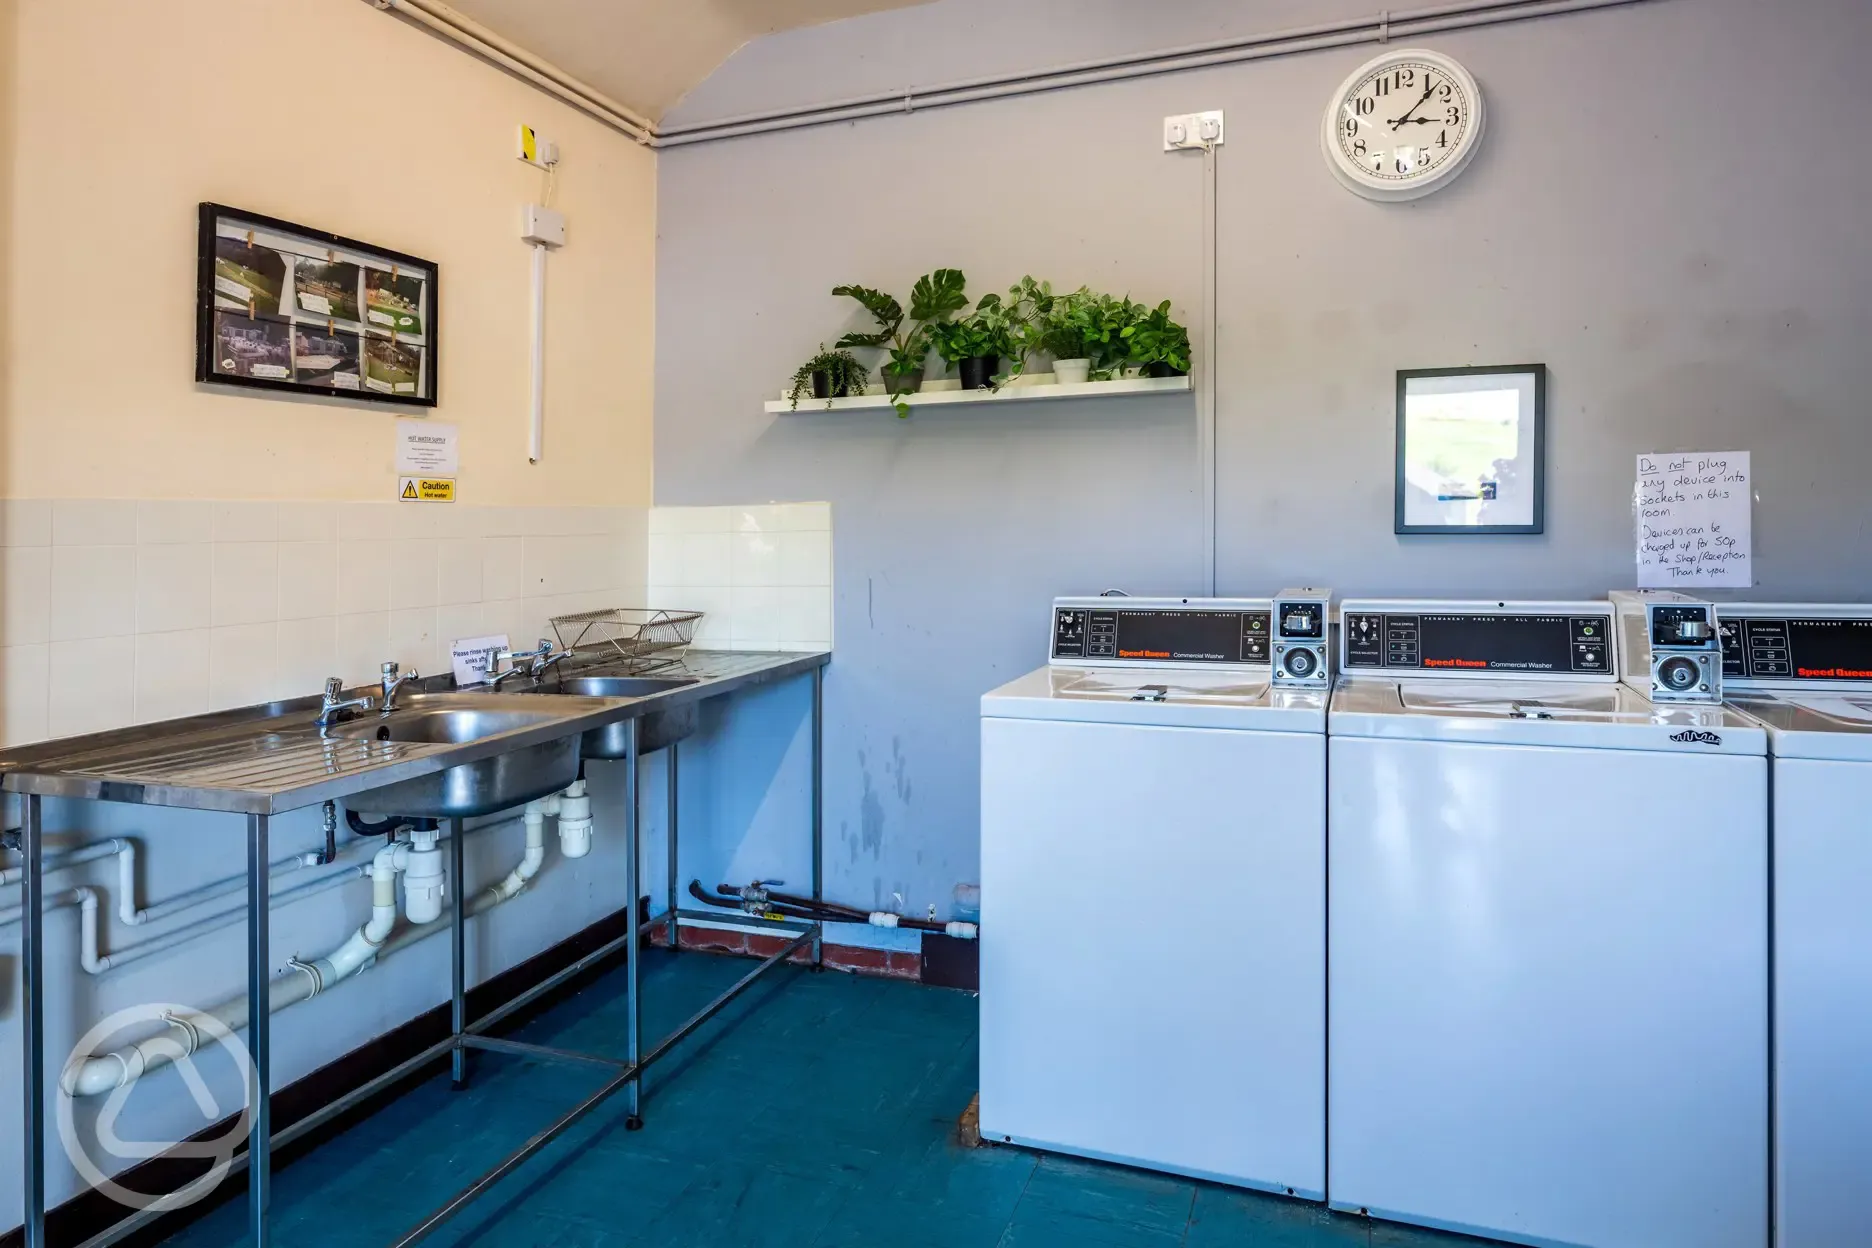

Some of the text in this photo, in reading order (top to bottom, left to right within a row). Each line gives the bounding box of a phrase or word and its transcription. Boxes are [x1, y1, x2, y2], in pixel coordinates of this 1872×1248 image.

[1375, 77, 1389, 96] 11
[1394, 69, 1414, 89] 12
[1424, 73, 1430, 92] 1
[1439, 84, 1452, 104] 2
[1355, 96, 1375, 116] 10
[1445, 106, 1460, 126] 3
[1346, 118, 1359, 138] 9
[1435, 129, 1448, 148] 4
[1353, 139, 1367, 157] 8
[1417, 146, 1431, 166] 5
[1640, 458, 1727, 475] Do not plug
[422, 481, 450, 491] Caution
[1673, 475, 1716, 486] device
[1724, 471, 1745, 482] into
[1707, 488, 1730, 499] this
[1643, 522, 1721, 539] Devices can be
[1641, 539, 1675, 555] charged
[1680, 542, 1691, 552] up
[1697, 538, 1709, 550] for
[1667, 566, 1702, 578] Thank
[1424, 658, 1454, 667] Speed
[1456, 659, 1487, 667] Queen
[1528, 661, 1553, 669] Washer
[1798, 667, 1835, 677] Speed
